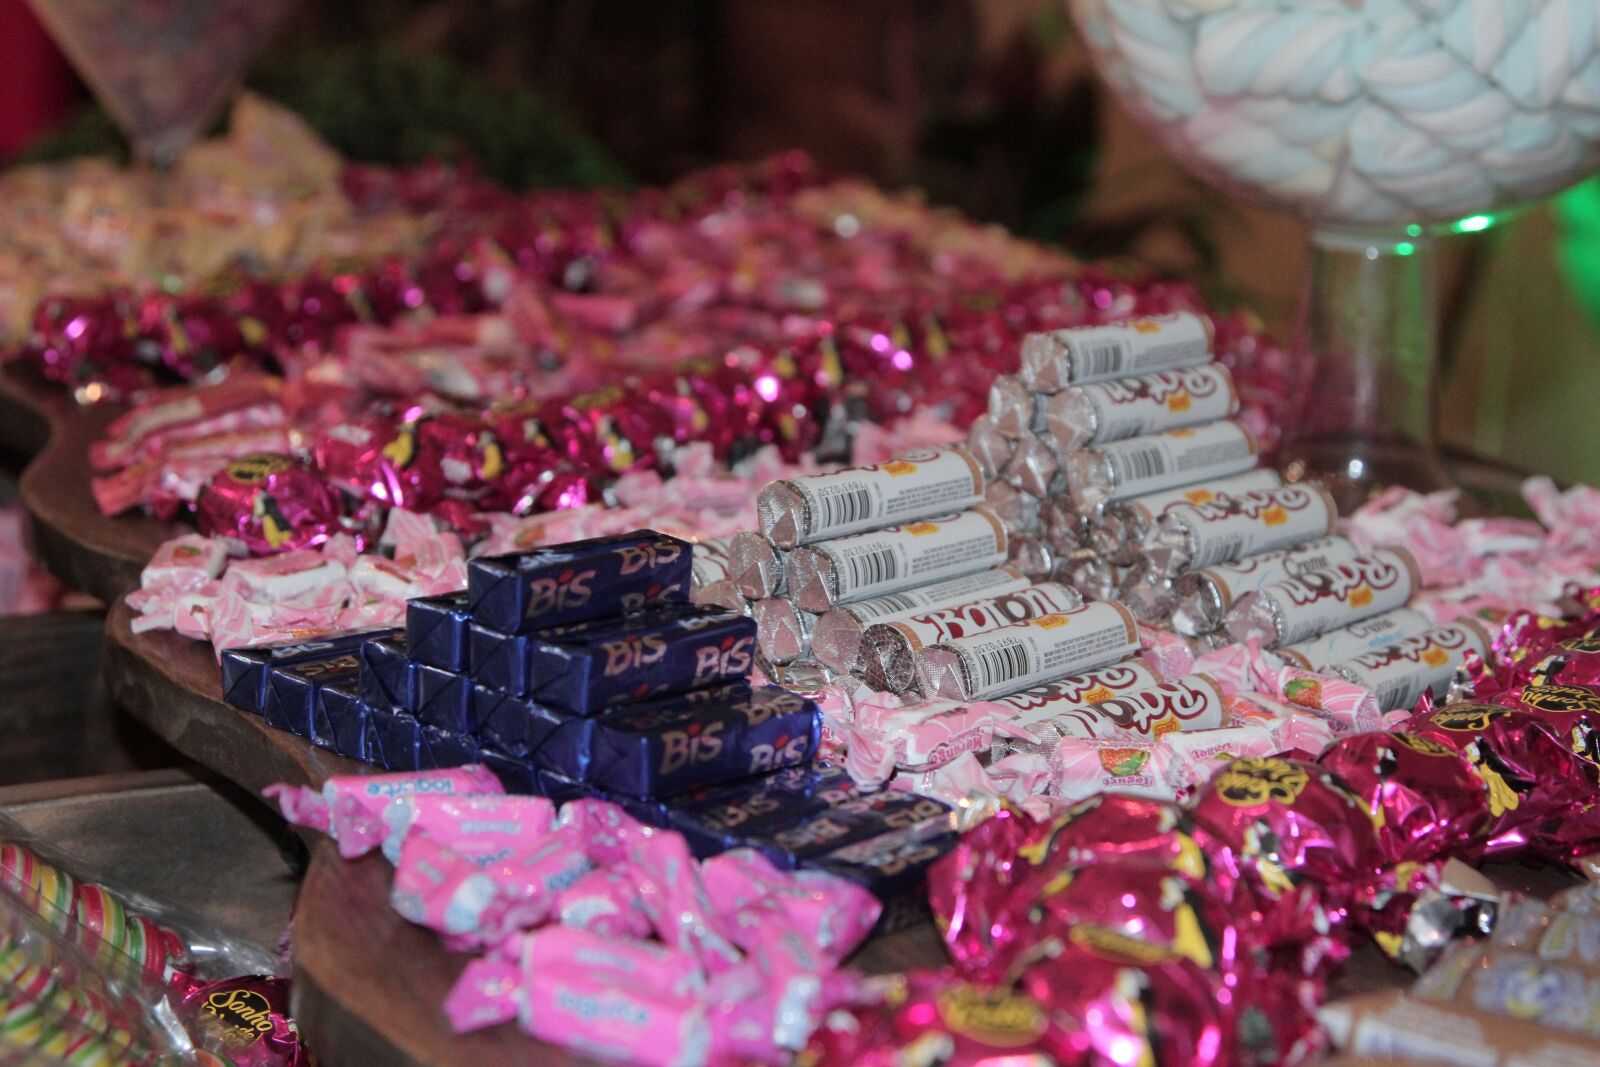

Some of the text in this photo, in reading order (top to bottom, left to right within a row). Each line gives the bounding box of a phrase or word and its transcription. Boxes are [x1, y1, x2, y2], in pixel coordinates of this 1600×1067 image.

[972, 637, 1024, 655] 7893 0230
[208, 988, 275, 1032] Sonho
